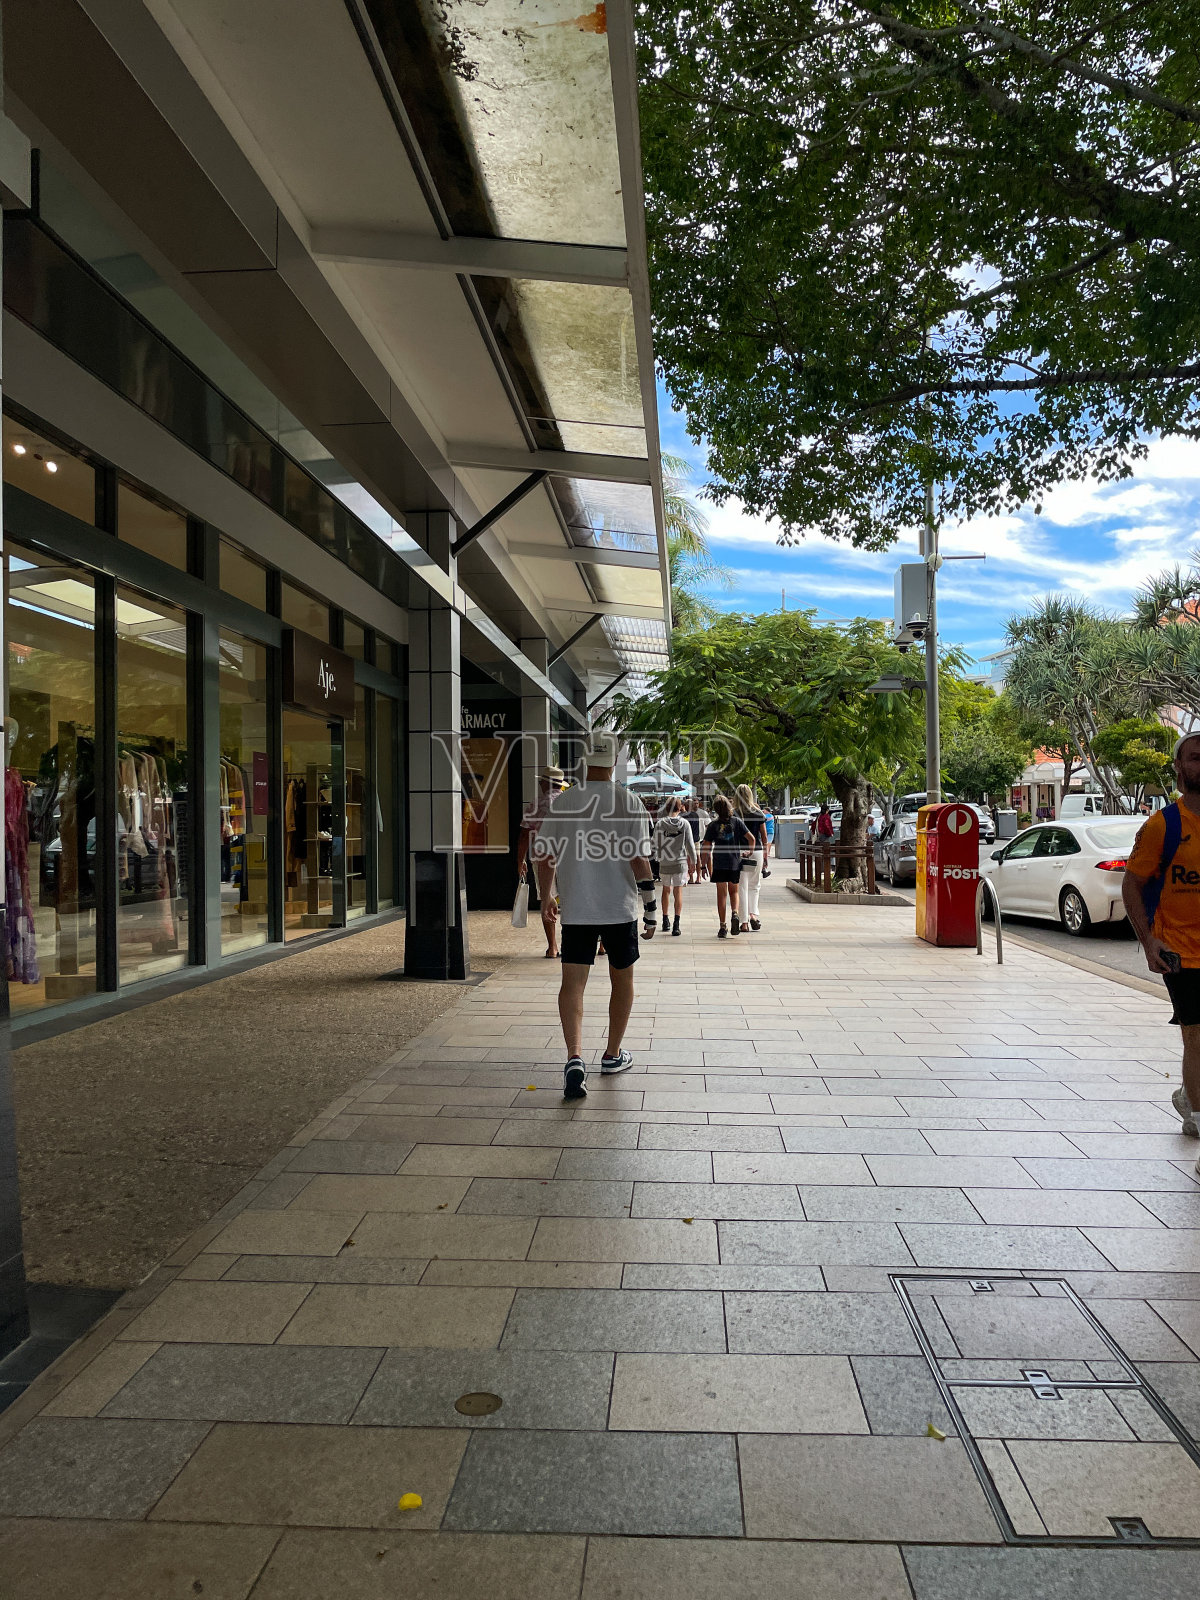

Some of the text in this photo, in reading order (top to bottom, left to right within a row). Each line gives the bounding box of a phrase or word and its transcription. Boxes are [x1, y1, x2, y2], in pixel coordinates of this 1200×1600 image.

[317, 658, 337, 699] Aje.
[943, 868, 979, 880] POST
[1171, 864, 1200, 885] Re
